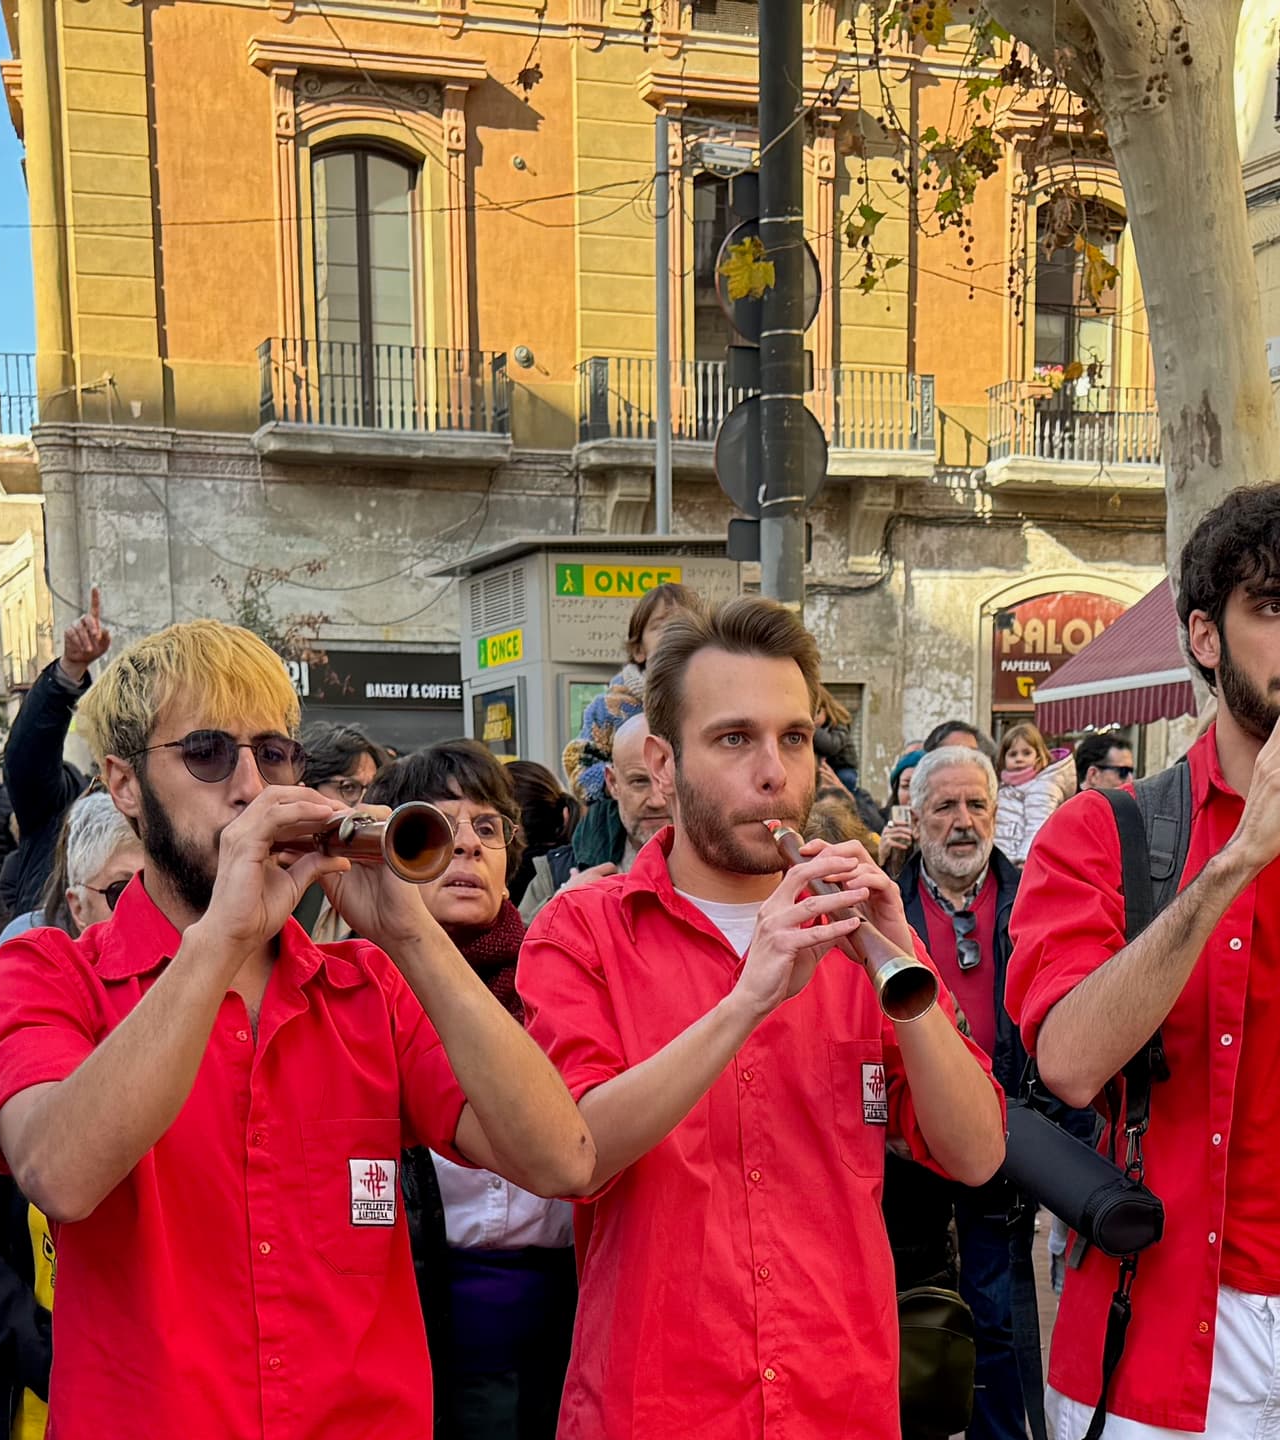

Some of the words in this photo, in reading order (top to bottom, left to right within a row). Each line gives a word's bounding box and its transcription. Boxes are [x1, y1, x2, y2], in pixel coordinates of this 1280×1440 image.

[490, 634, 519, 659] ONCE
[1000, 660, 1052, 672] PAPERERIA
[366, 683, 408, 698] BAKERY
[411, 684, 421, 698] &
[421, 684, 462, 699] COFFEE
